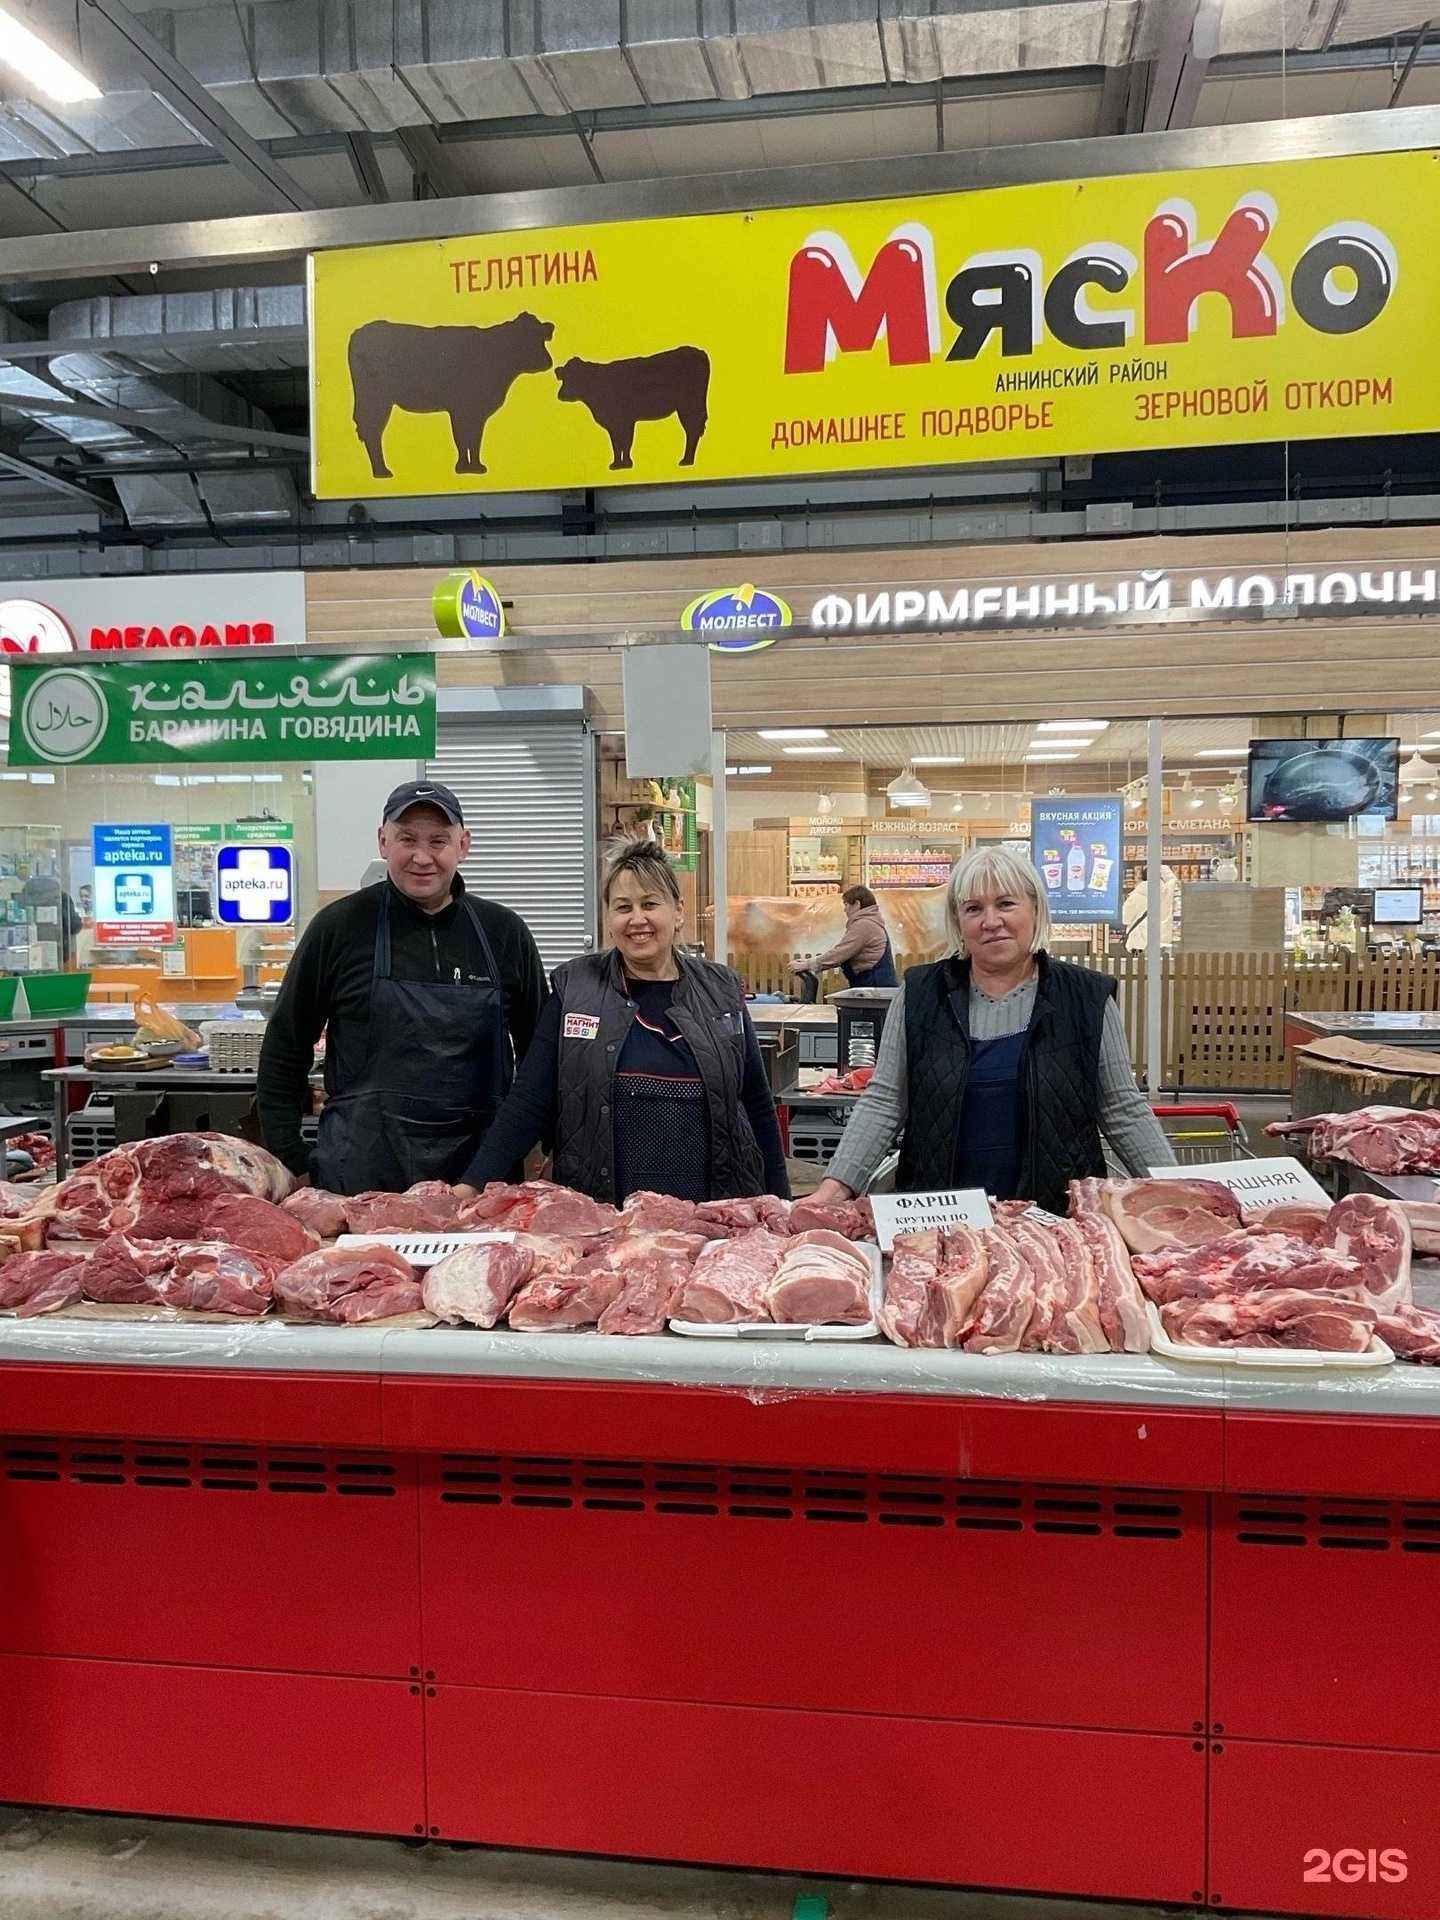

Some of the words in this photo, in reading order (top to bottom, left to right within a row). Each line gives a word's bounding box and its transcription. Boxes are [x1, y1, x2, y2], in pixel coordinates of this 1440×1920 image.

[449, 249, 599, 294] ТЕЛЯТИНА
[995, 361, 1100, 393] АННИНСКИЙ
[1109, 360, 1168, 385] РАЙОН
[1135, 379, 1269, 421] ЗЕРНОВОЙ
[1284, 377, 1393, 411] ОТКОРМ
[771, 413, 906, 450] ДОМАШНЕЕ
[921, 402, 1054, 437] ПОДВОРЬЕ
[810, 569, 1171, 627] ФИРМЕННЫЙ
[462, 602, 497, 629] МОЛВЕСТ
[700, 613, 777, 630] МОЛВЕСТ
[129, 718, 267, 743] БАРАНИНА
[280, 714, 421, 742] ГОВЯДИНА
[1040, 812, 1079, 821] ВКУСНАЯ
[1082, 811, 1112, 822] АКЦИЯ
[1168, 819, 1232, 831] СМЕТАНА
[872, 819, 917, 832] НЕЖНЫЙ
[919, 821, 960, 833] ВОЗРАСТ
[104, 849, 163, 863] apteka.ru
[225, 878, 283, 891] apteka.ru
[896, 1194, 958, 1208] ФАРШ
[895, 1215, 947, 1225] КРУТИМ
[950, 1213, 968, 1221] ПО
